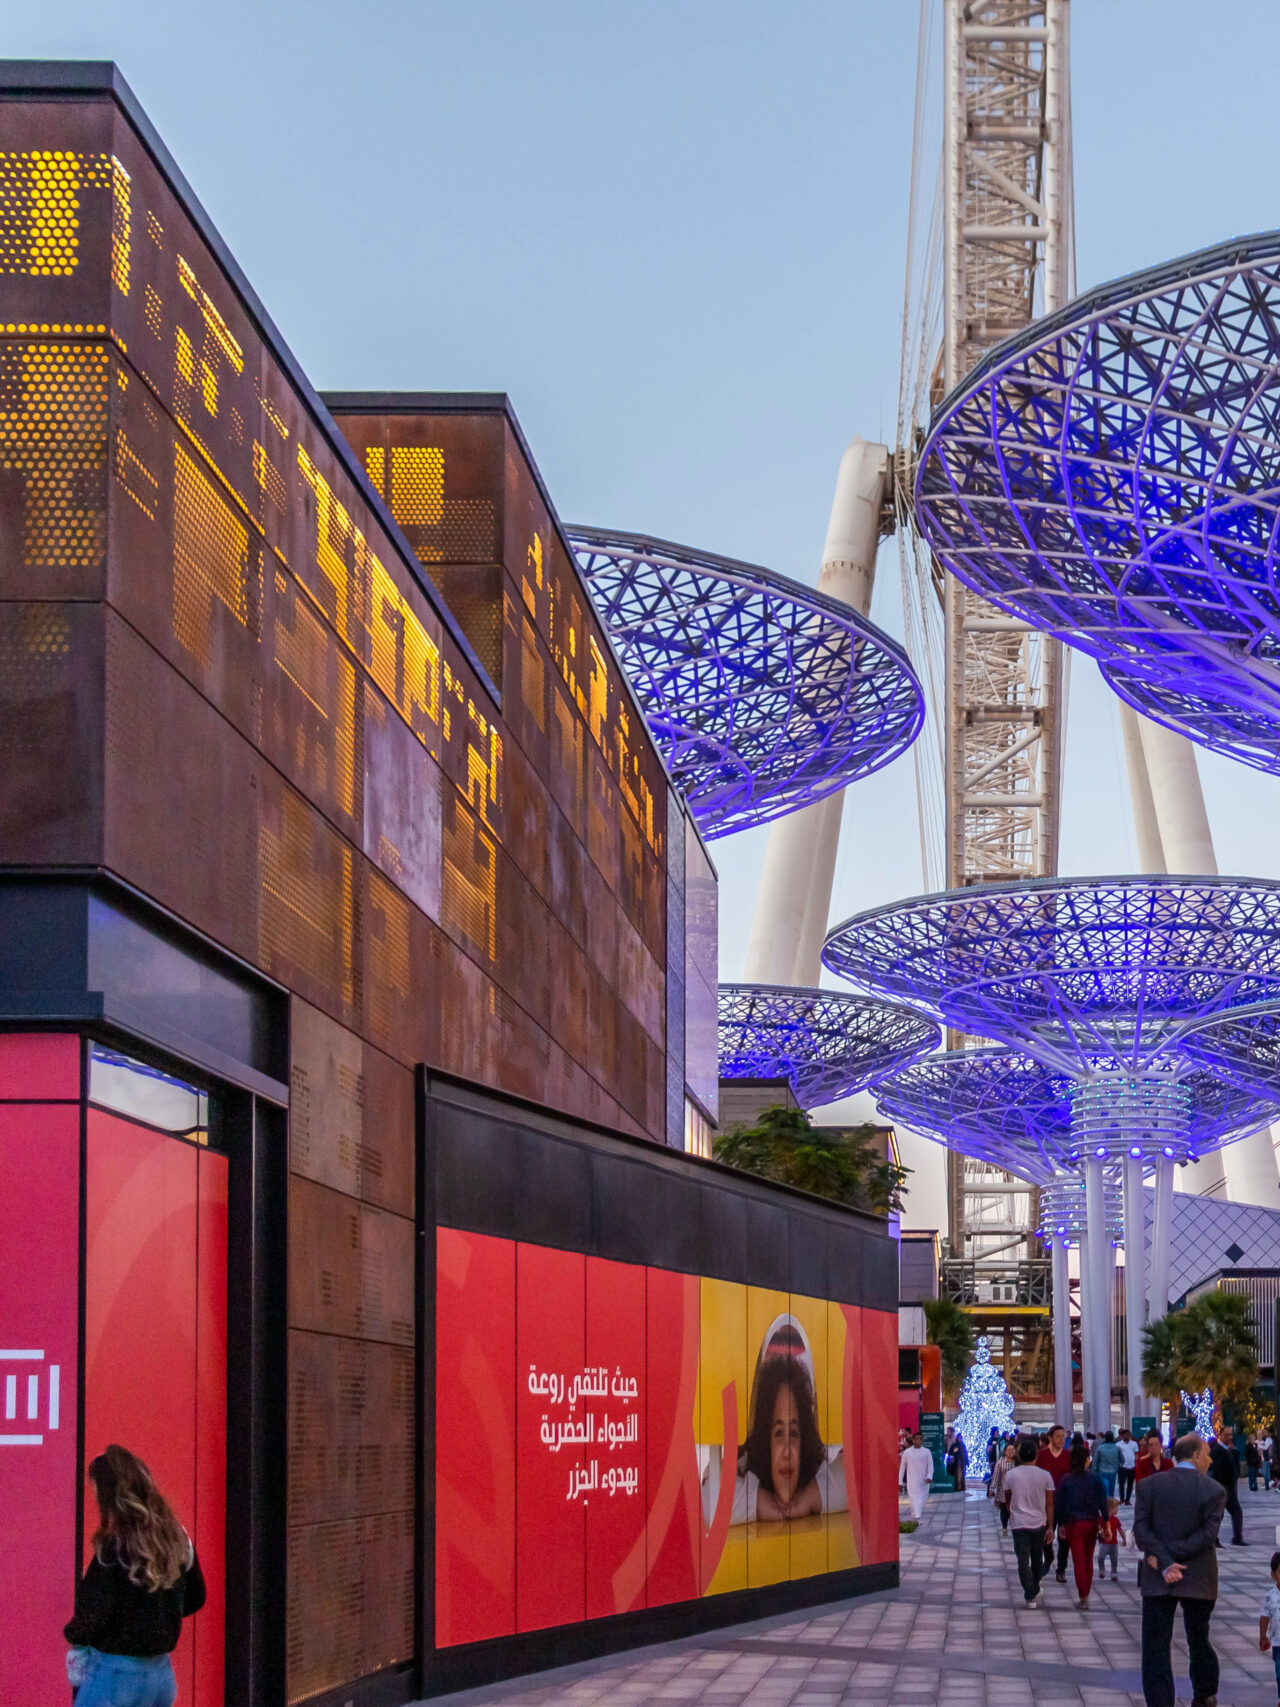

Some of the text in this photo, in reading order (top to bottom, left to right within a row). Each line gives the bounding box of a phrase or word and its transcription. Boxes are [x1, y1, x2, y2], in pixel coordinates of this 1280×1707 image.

[528, 1364, 638, 1411] حيث تلتقي روعة
[540, 1413, 638, 1452] الأجواء الحضرية
[566, 1460, 638, 1505] بهدوء الجزر
